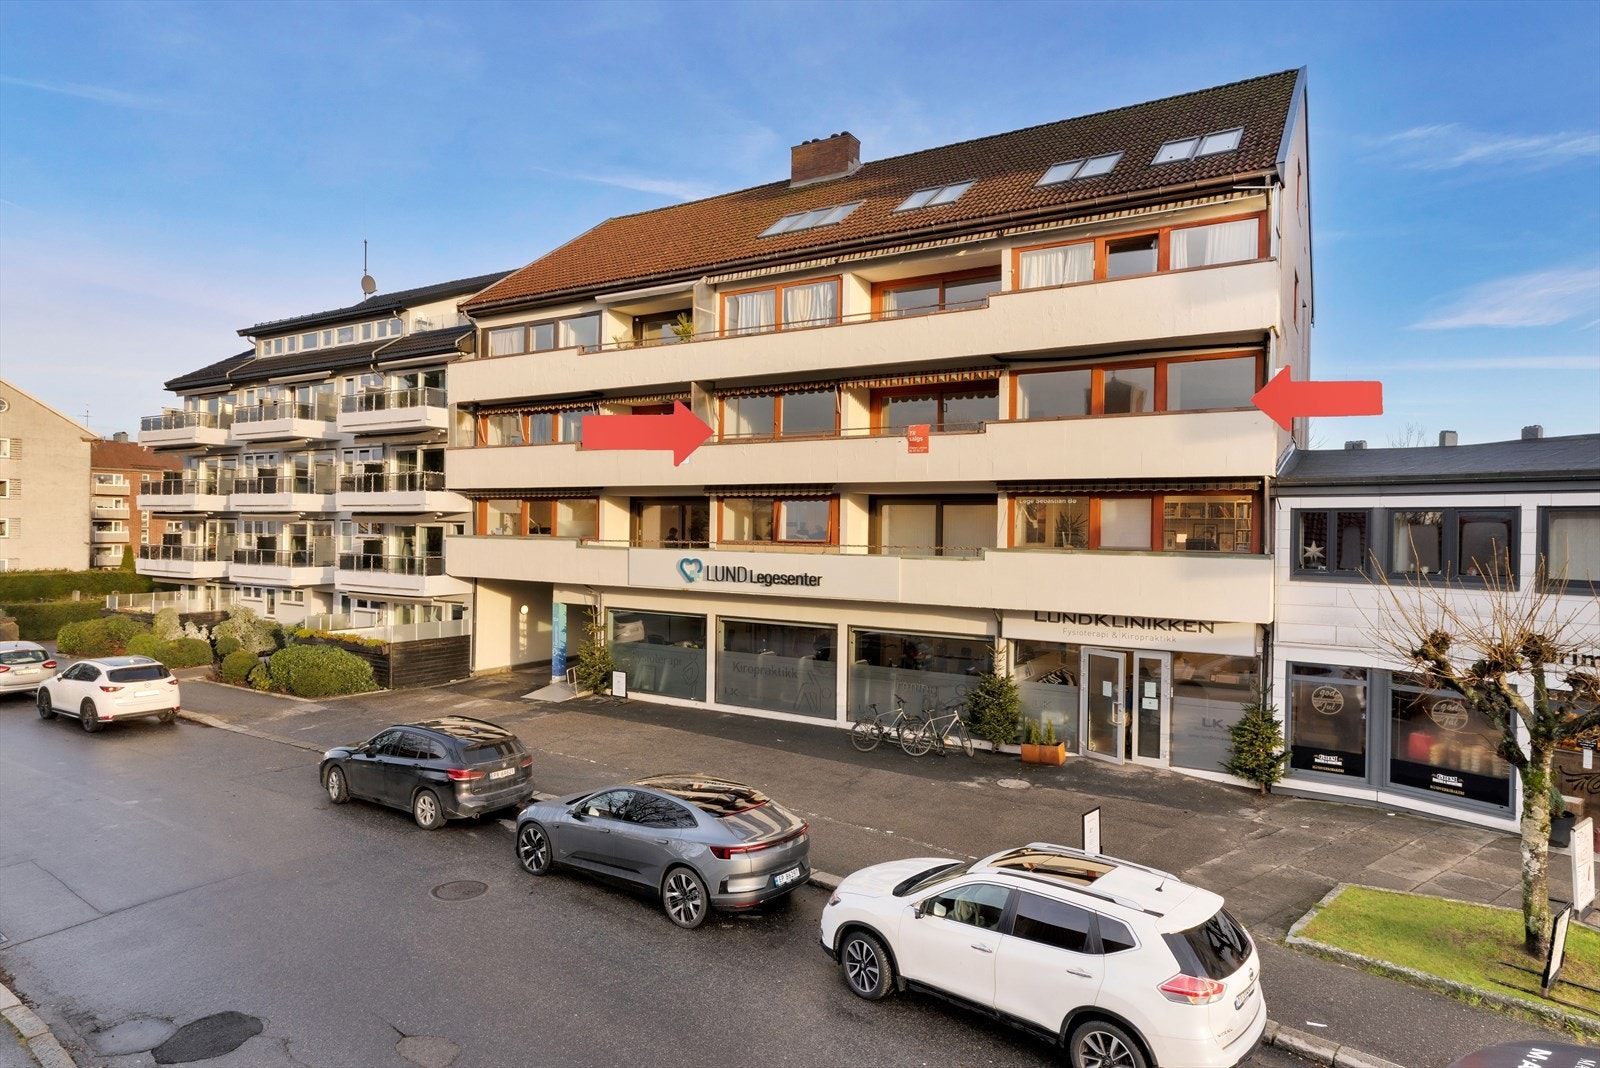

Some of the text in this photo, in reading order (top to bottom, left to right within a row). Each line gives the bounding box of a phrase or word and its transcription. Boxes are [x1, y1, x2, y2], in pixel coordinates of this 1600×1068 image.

[706, 564, 823, 587] LUND Legesenter
[1034, 610, 1215, 634] LUNDKLINIKKEN
[1062, 628, 1177, 643] Fysioterapi & Kiropraktikk
[732, 660, 798, 678] Kiropraktikk
[1202, 717, 1224, 729] LK
